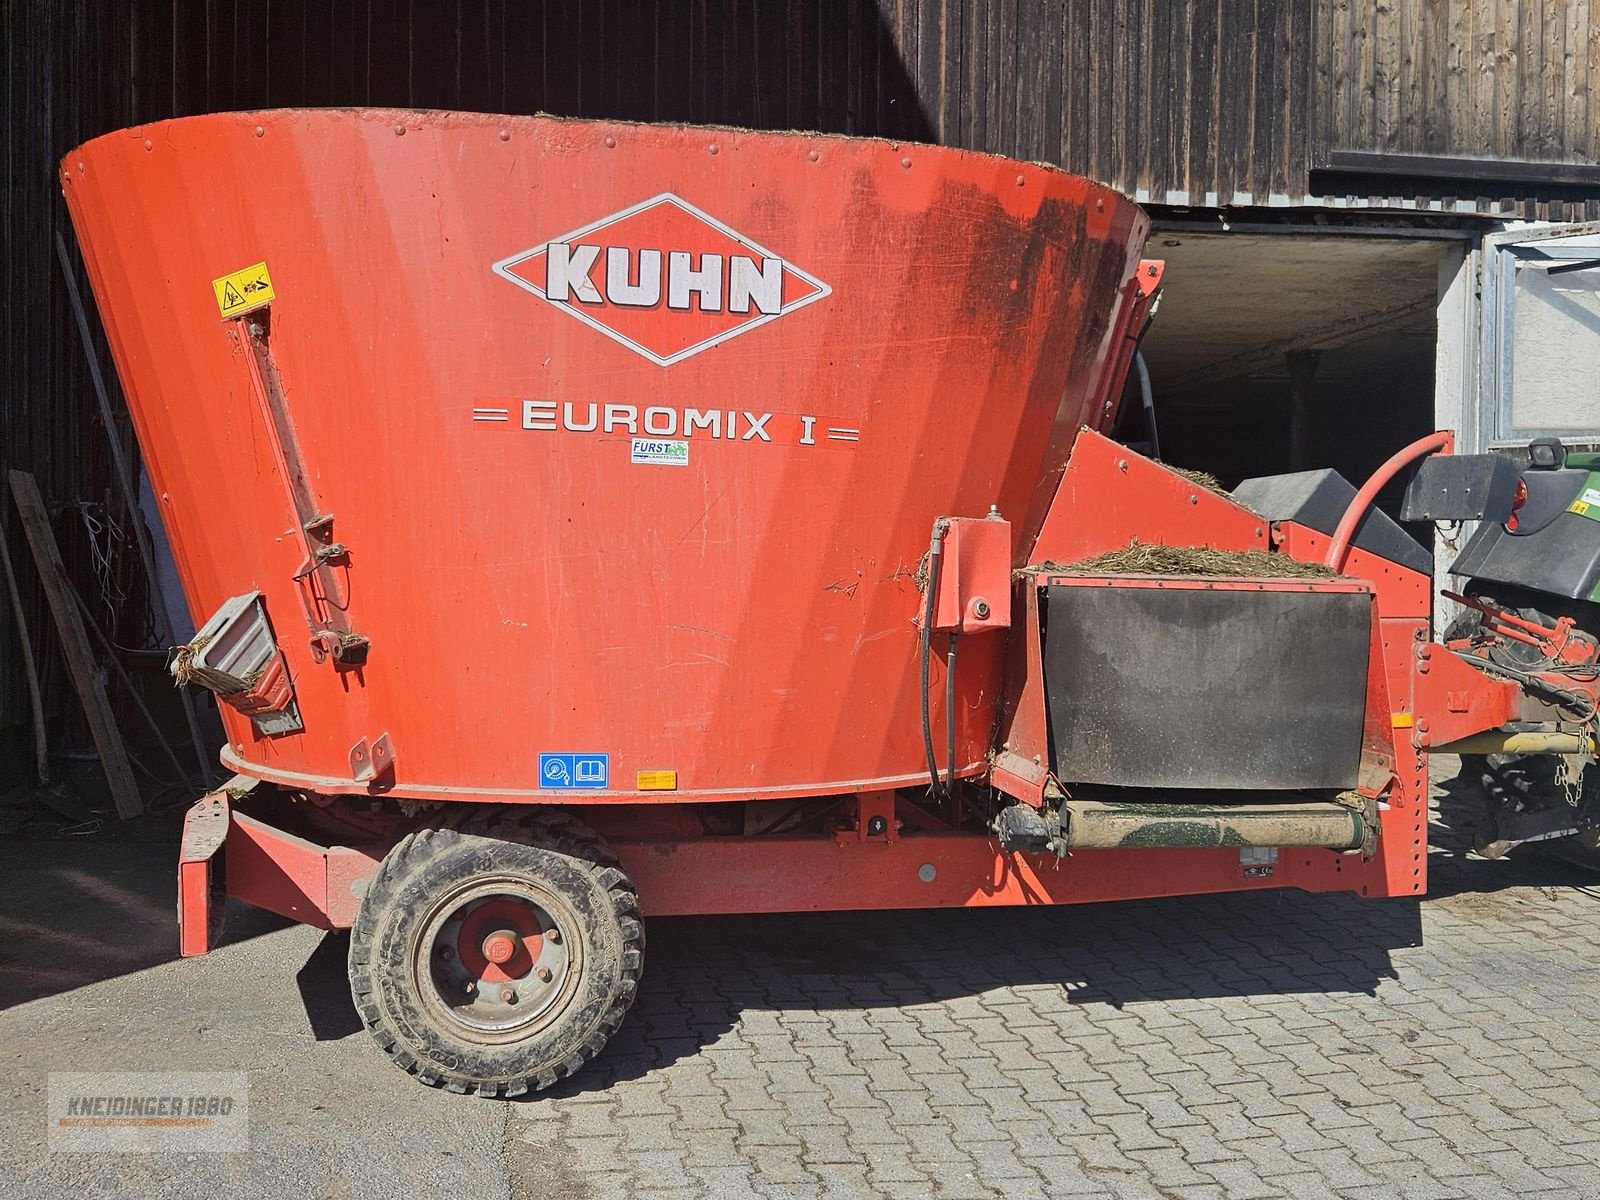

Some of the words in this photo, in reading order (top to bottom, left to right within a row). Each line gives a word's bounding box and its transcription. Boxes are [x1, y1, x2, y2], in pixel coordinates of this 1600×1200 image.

[546, 242, 783, 314] KUHN
[522, 399, 773, 442] EUROMIX
[799, 415, 816, 445] I
[633, 440, 671, 453] FÜRST
